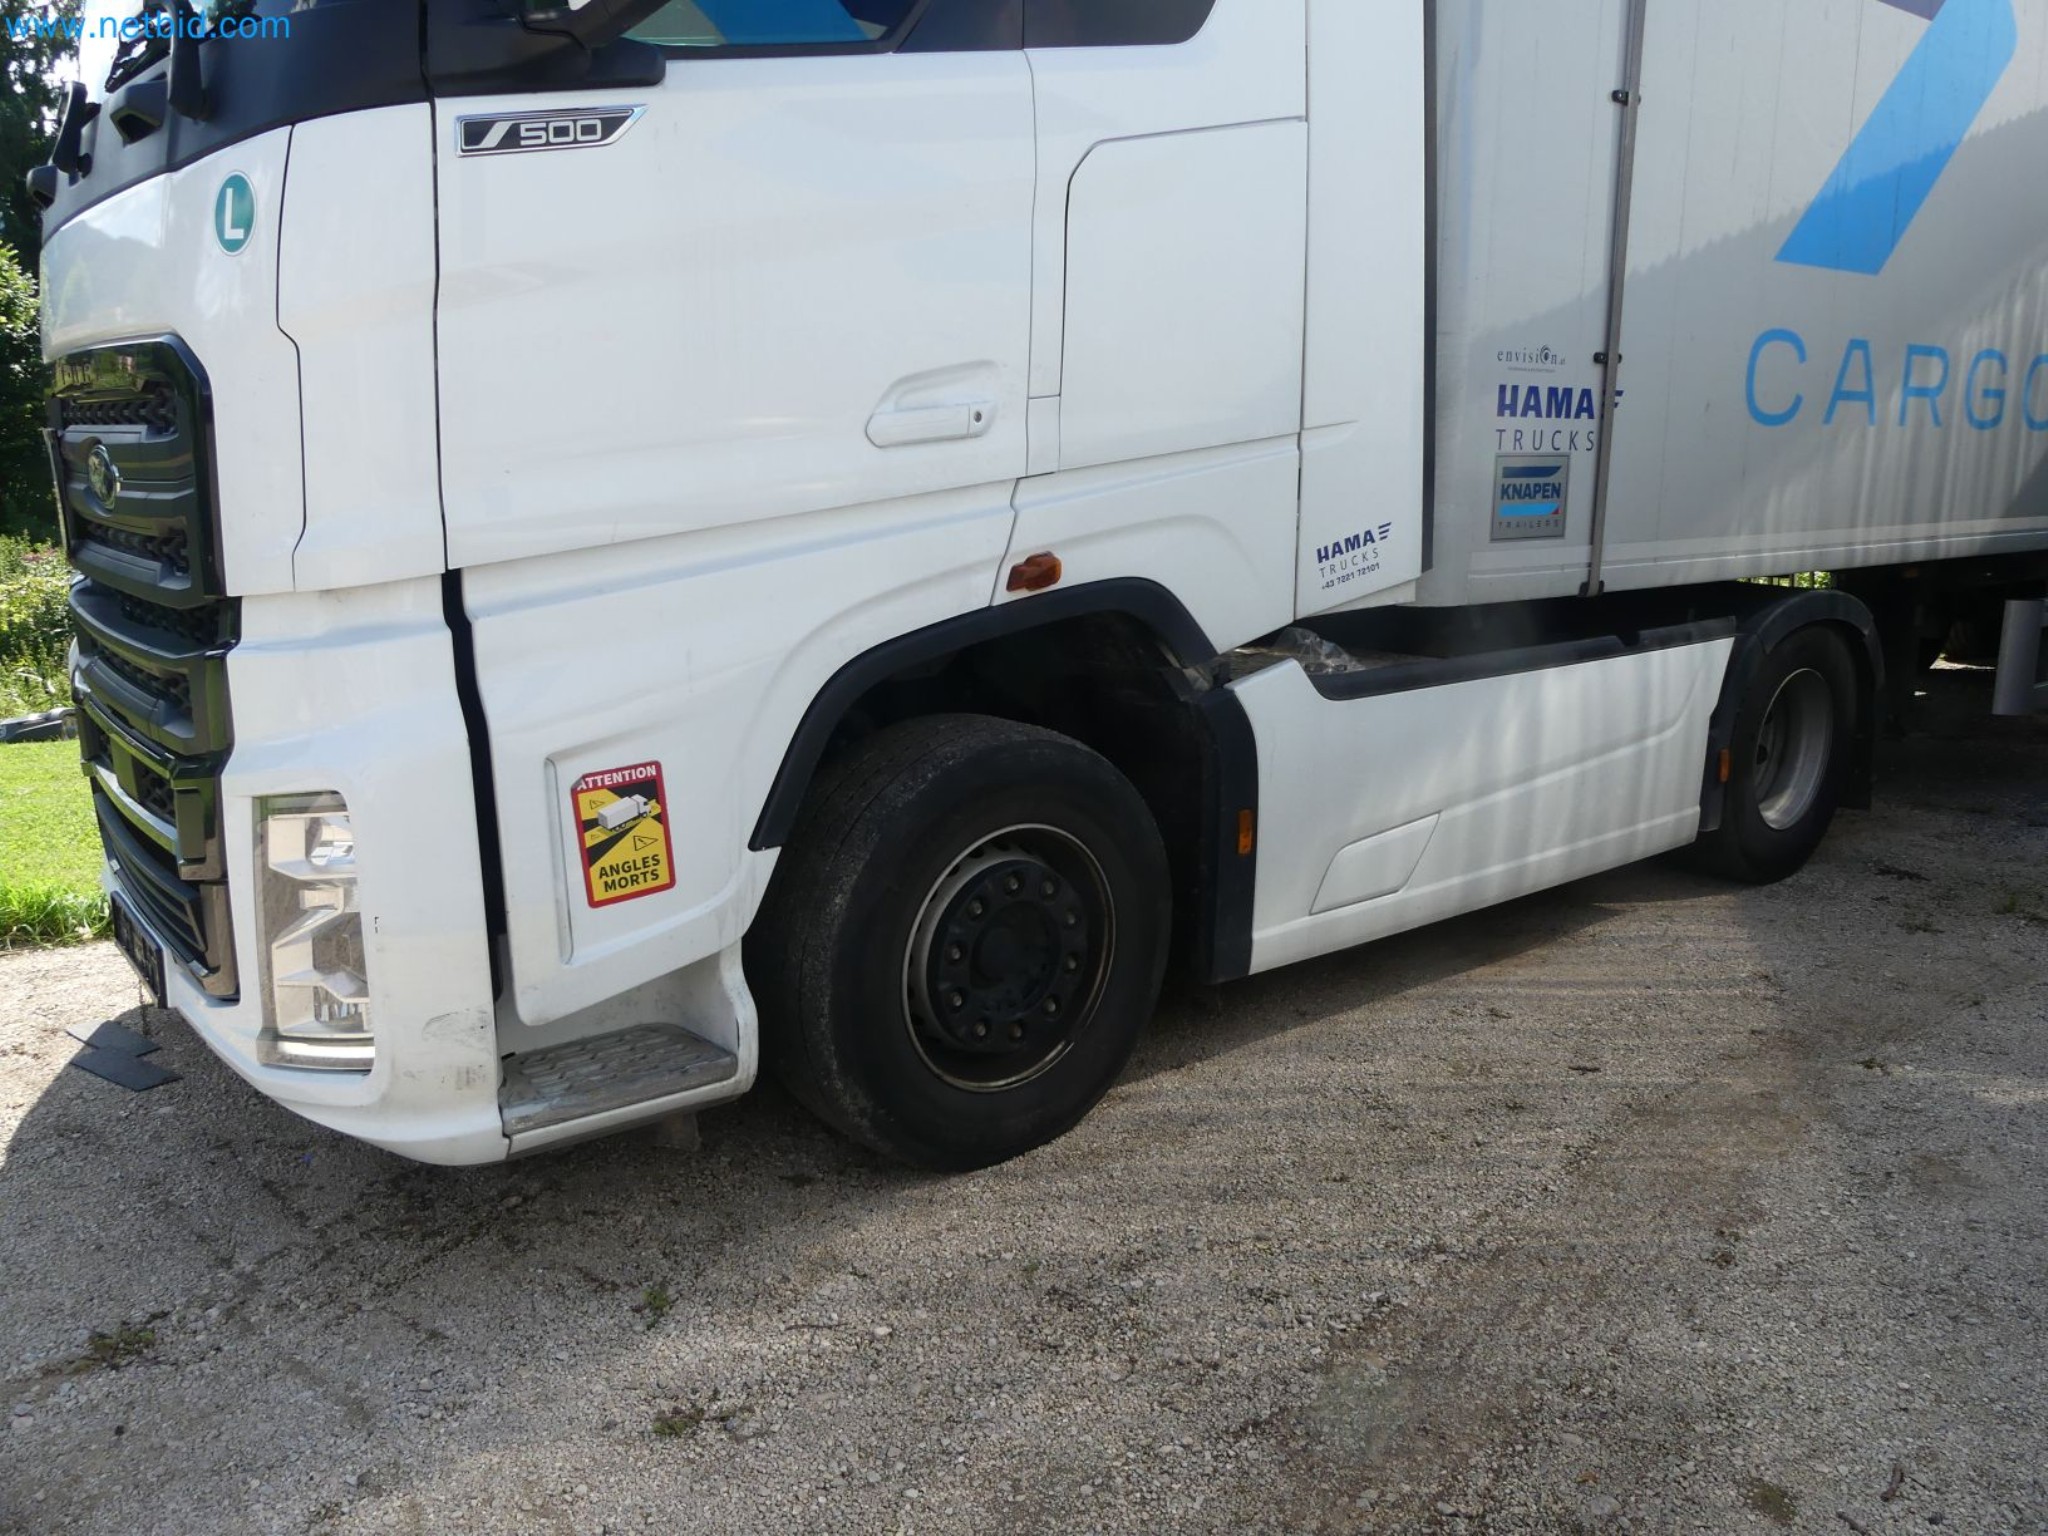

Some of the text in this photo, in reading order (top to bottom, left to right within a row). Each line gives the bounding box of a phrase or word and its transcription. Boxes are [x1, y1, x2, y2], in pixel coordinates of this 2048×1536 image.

[520, 119, 602, 145] 500
[224, 187, 244, 239] L
[1497, 384, 1595, 419] HAMA
[1496, 429, 1595, 451] TRUCKS
[1501, 482, 1561, 500] KNAPEN
[1316, 529, 1375, 563] HAMA
[1319, 548, 1378, 578] TRUCKS
[576, 764, 657, 791] ATTENTION
[599, 854, 661, 879] ANGLES
[603, 869, 660, 893] MORTS
